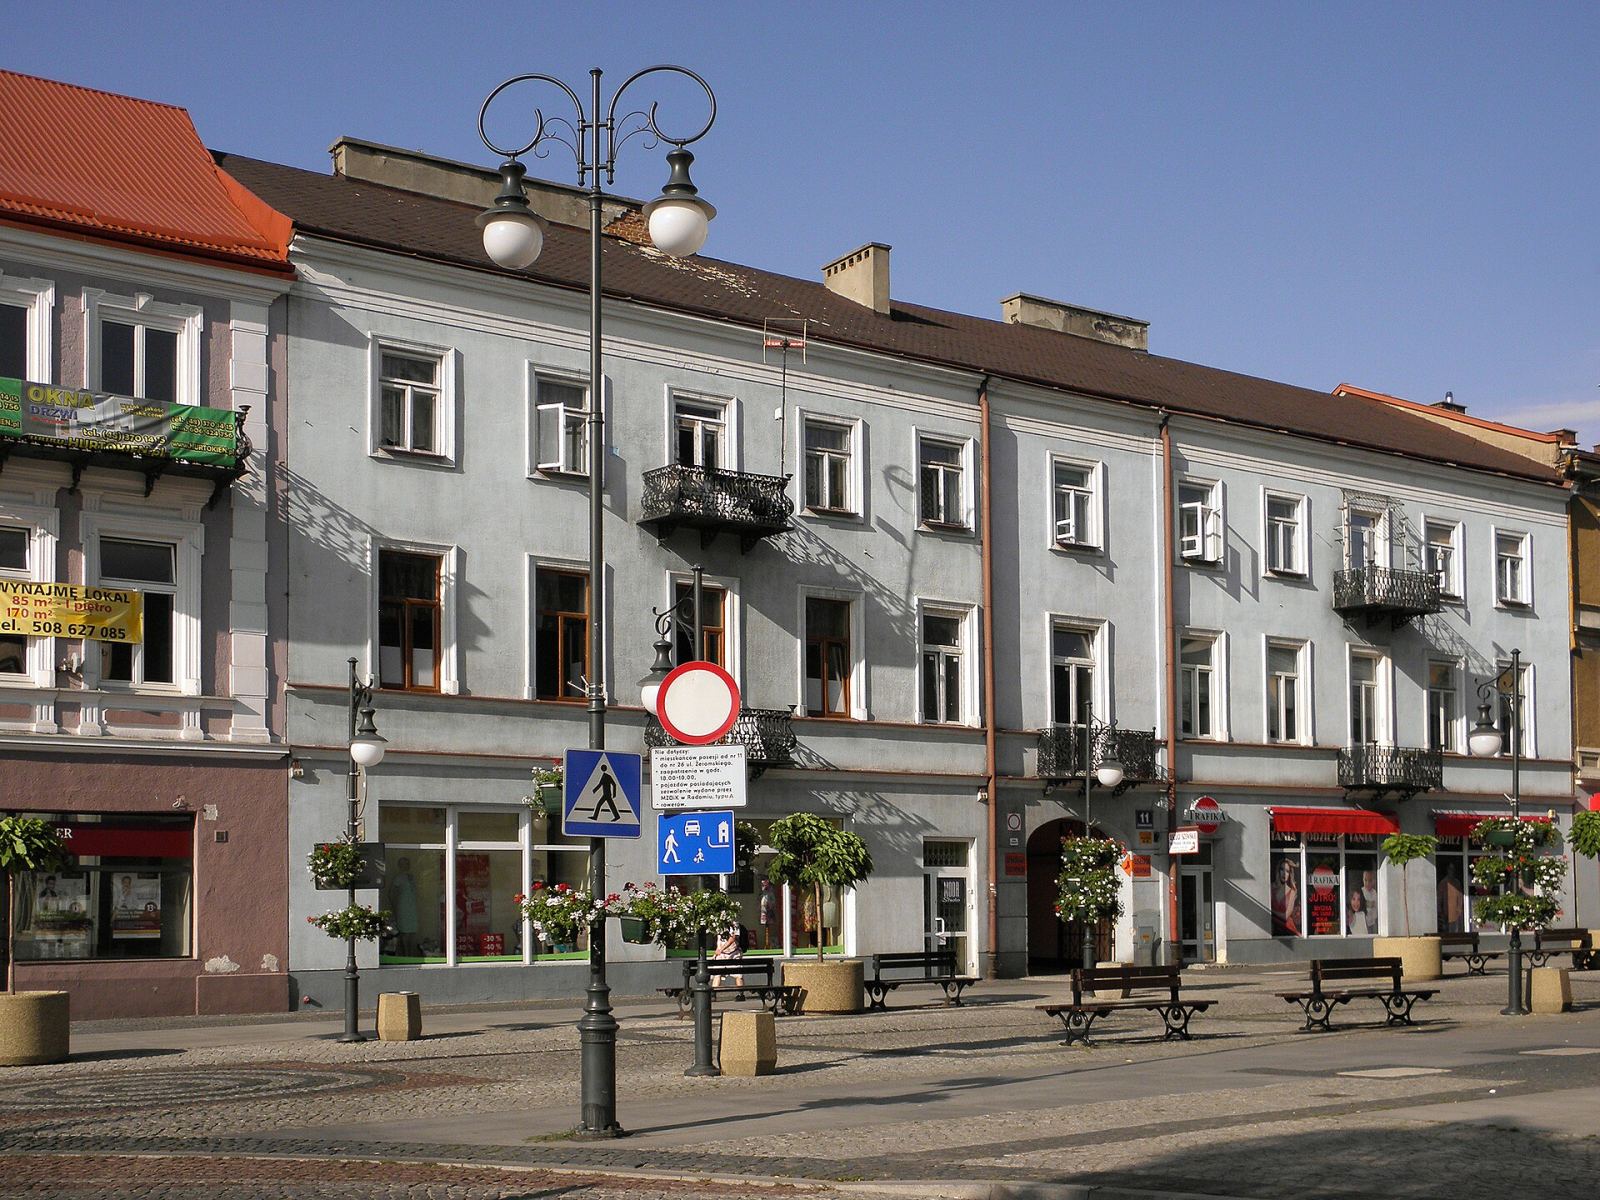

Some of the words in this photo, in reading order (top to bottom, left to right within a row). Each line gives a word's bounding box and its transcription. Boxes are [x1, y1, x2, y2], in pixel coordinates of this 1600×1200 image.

[28, 385, 95, 409] OKNA
[31, 405, 78, 420] DRZWI
[82, 427, 100, 437] tel.
[125, 433, 141, 442] 370
[0, 582, 78, 600] WYNAJMĘ
[84, 588, 130, 603] LOKAL
[12, 595, 29, 606] 85
[74, 600, 112, 613] piętro
[6, 607, 29, 618] 170
[0, 619, 21, 631] el.
[32, 621, 62, 634] 508
[68, 624, 96, 637] 627
[100, 626, 126, 640] 085
[693, 787, 715, 795] wydane
[1140, 812, 1149, 824] 11
[1189, 810, 1226, 821] TRAFIKA
[56, 827, 73, 839] ER
[1308, 875, 1340, 886] TRAFIKA
